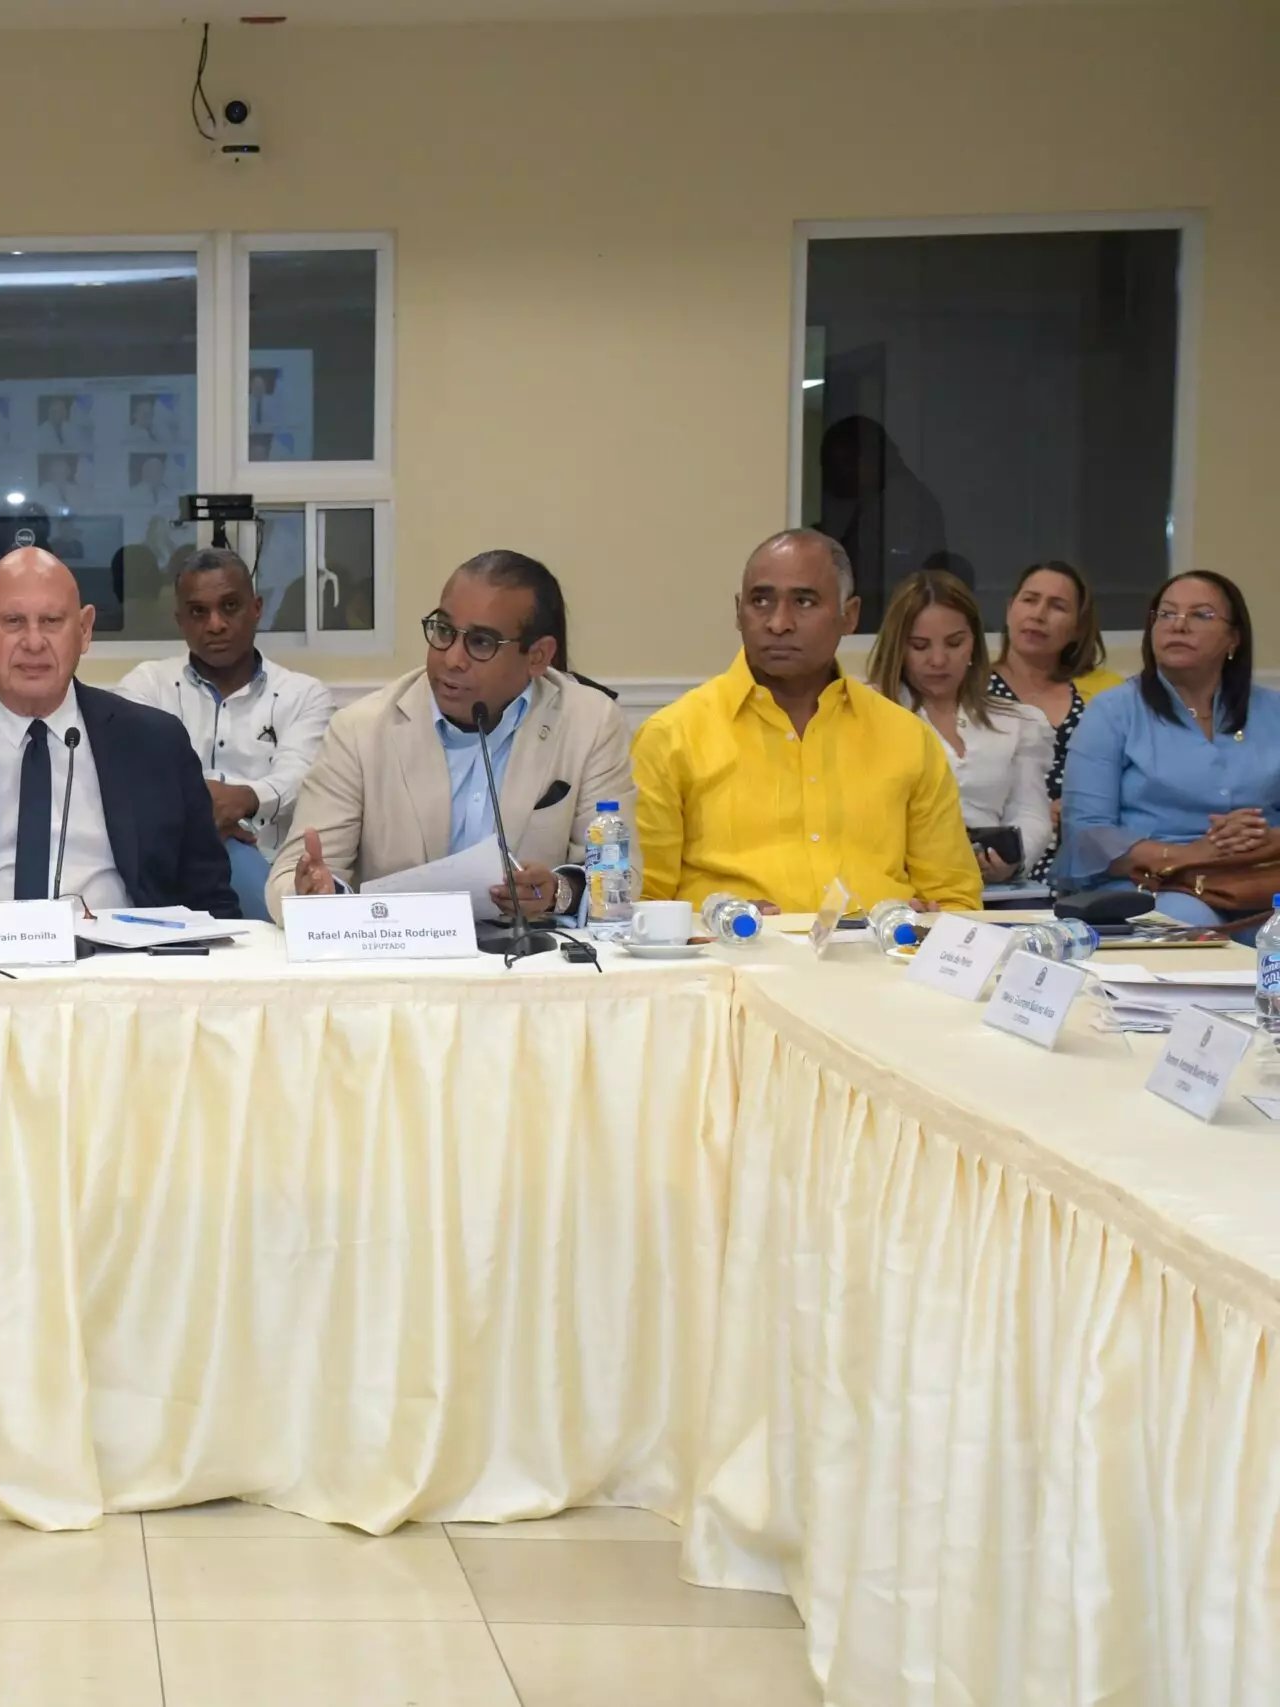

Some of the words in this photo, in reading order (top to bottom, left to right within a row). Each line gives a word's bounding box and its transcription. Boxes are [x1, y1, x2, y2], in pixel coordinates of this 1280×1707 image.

[20, 931, 57, 941] Bonilla
[308, 929, 340, 940] Rafael
[361, 942, 406, 950] DIPUTADO
